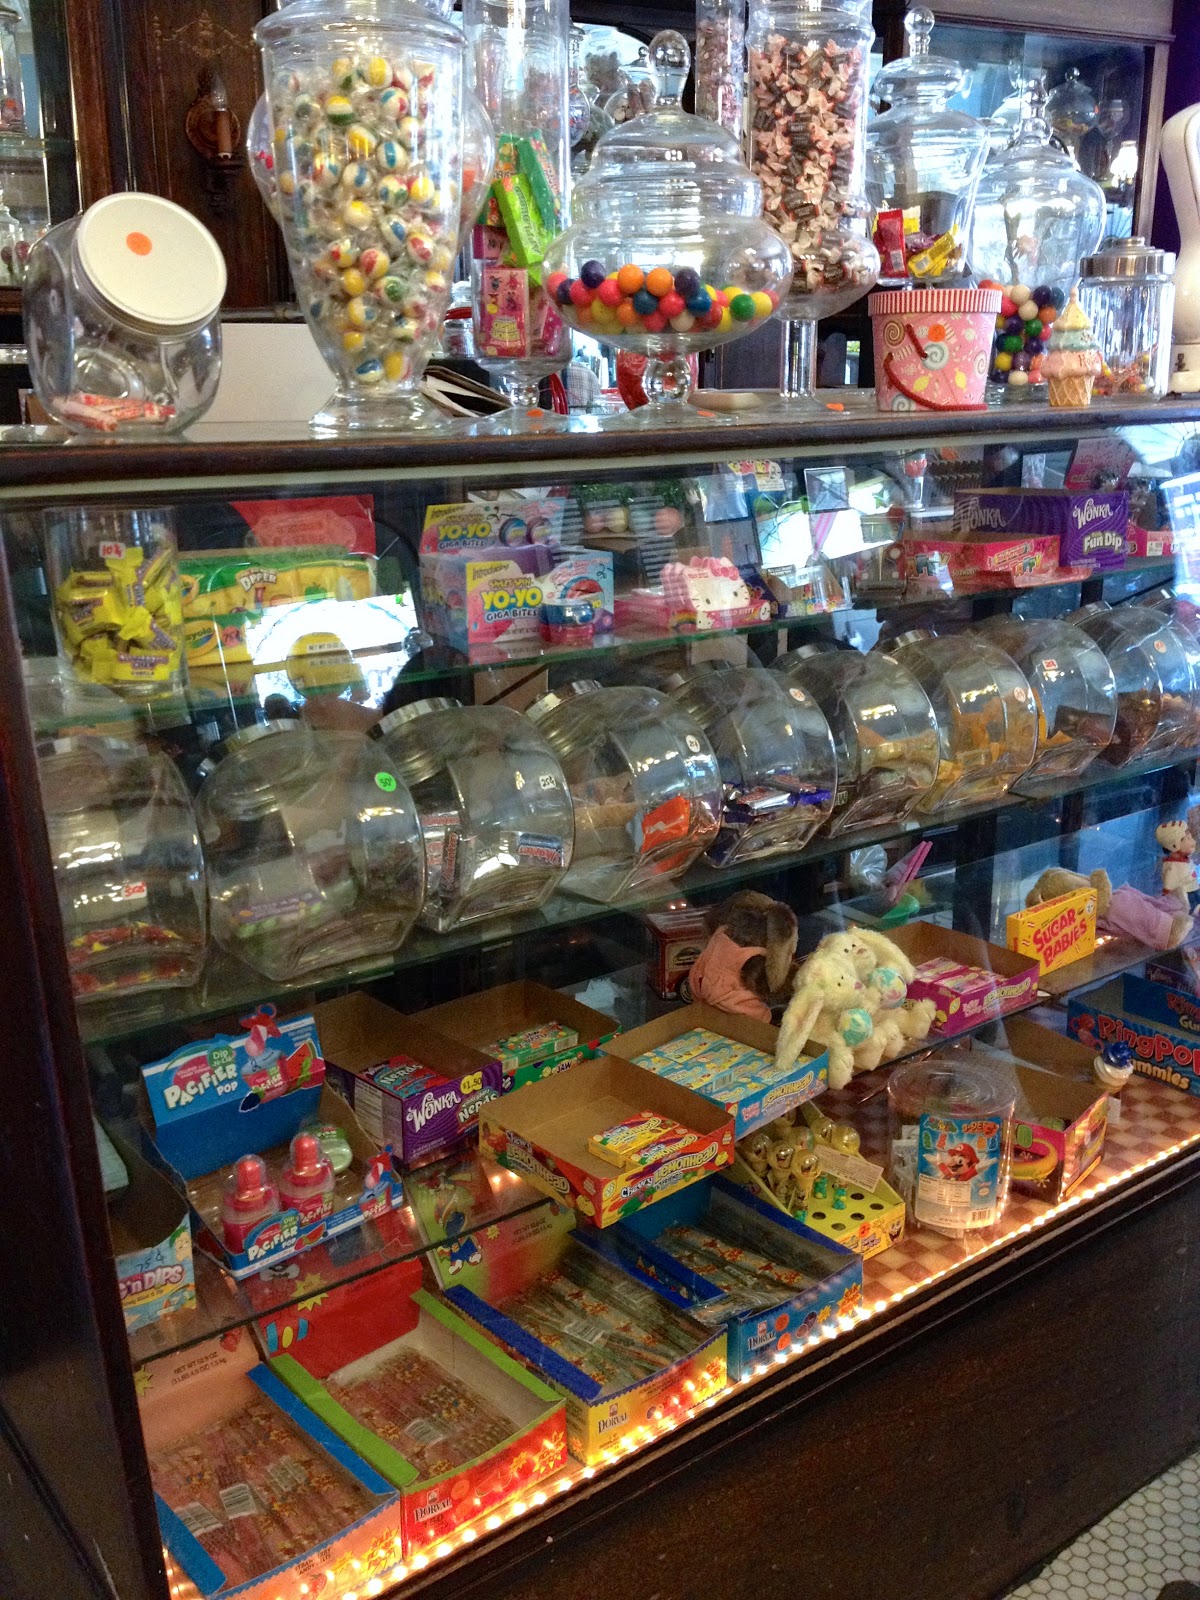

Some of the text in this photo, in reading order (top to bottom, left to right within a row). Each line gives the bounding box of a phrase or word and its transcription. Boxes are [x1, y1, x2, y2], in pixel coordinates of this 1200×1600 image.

[1072, 498, 1113, 530] WONKA
[438, 521, 491, 540] YO-YO
[439, 541, 460, 550] GIGA
[1083, 535, 1122, 553] Fun Dip
[480, 586, 543, 610] YO-YO
[485, 608, 540, 622] GIGA BITES
[1033, 908, 1076, 953] SUGAR
[1042, 918, 1087, 968] BABIES
[557, 1061, 572, 1073] JAW
[164, 1063, 238, 1109] PACIFIER
[216, 1081, 238, 1096] POP
[462, 1077, 482, 1091] $1.50
[406, 1091, 461, 1133] WONKA
[621, 1176, 654, 1199] Chewy
[248, 1225, 298, 1262] PACIFIER
[281, 1238, 297, 1249] POP
[143, 1264, 183, 1291] DIPS
[598, 1412, 628, 1434] DORVAL
[413, 1498, 453, 1524] DORVAL
